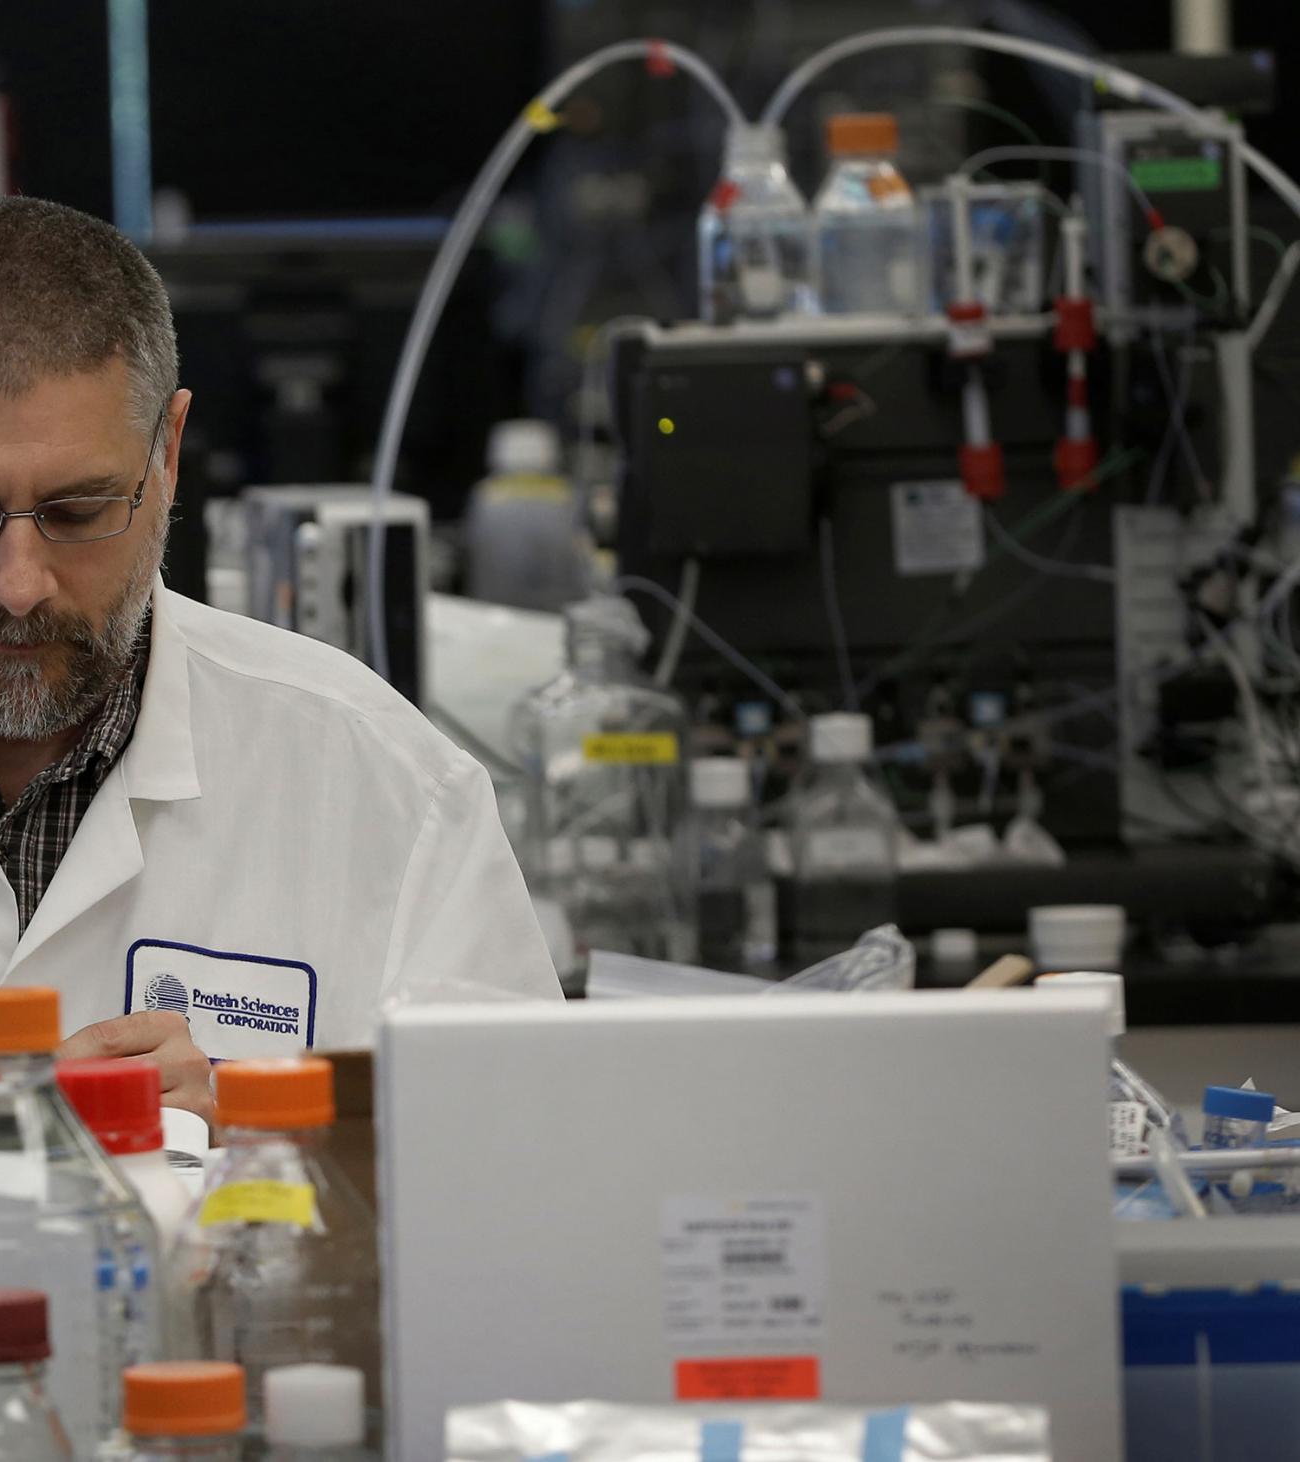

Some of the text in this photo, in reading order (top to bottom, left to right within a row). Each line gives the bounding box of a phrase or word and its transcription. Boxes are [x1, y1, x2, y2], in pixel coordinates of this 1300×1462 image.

[193, 989, 299, 1017] Protein Sciences
[217, 1014, 299, 1034] CORPORATION
